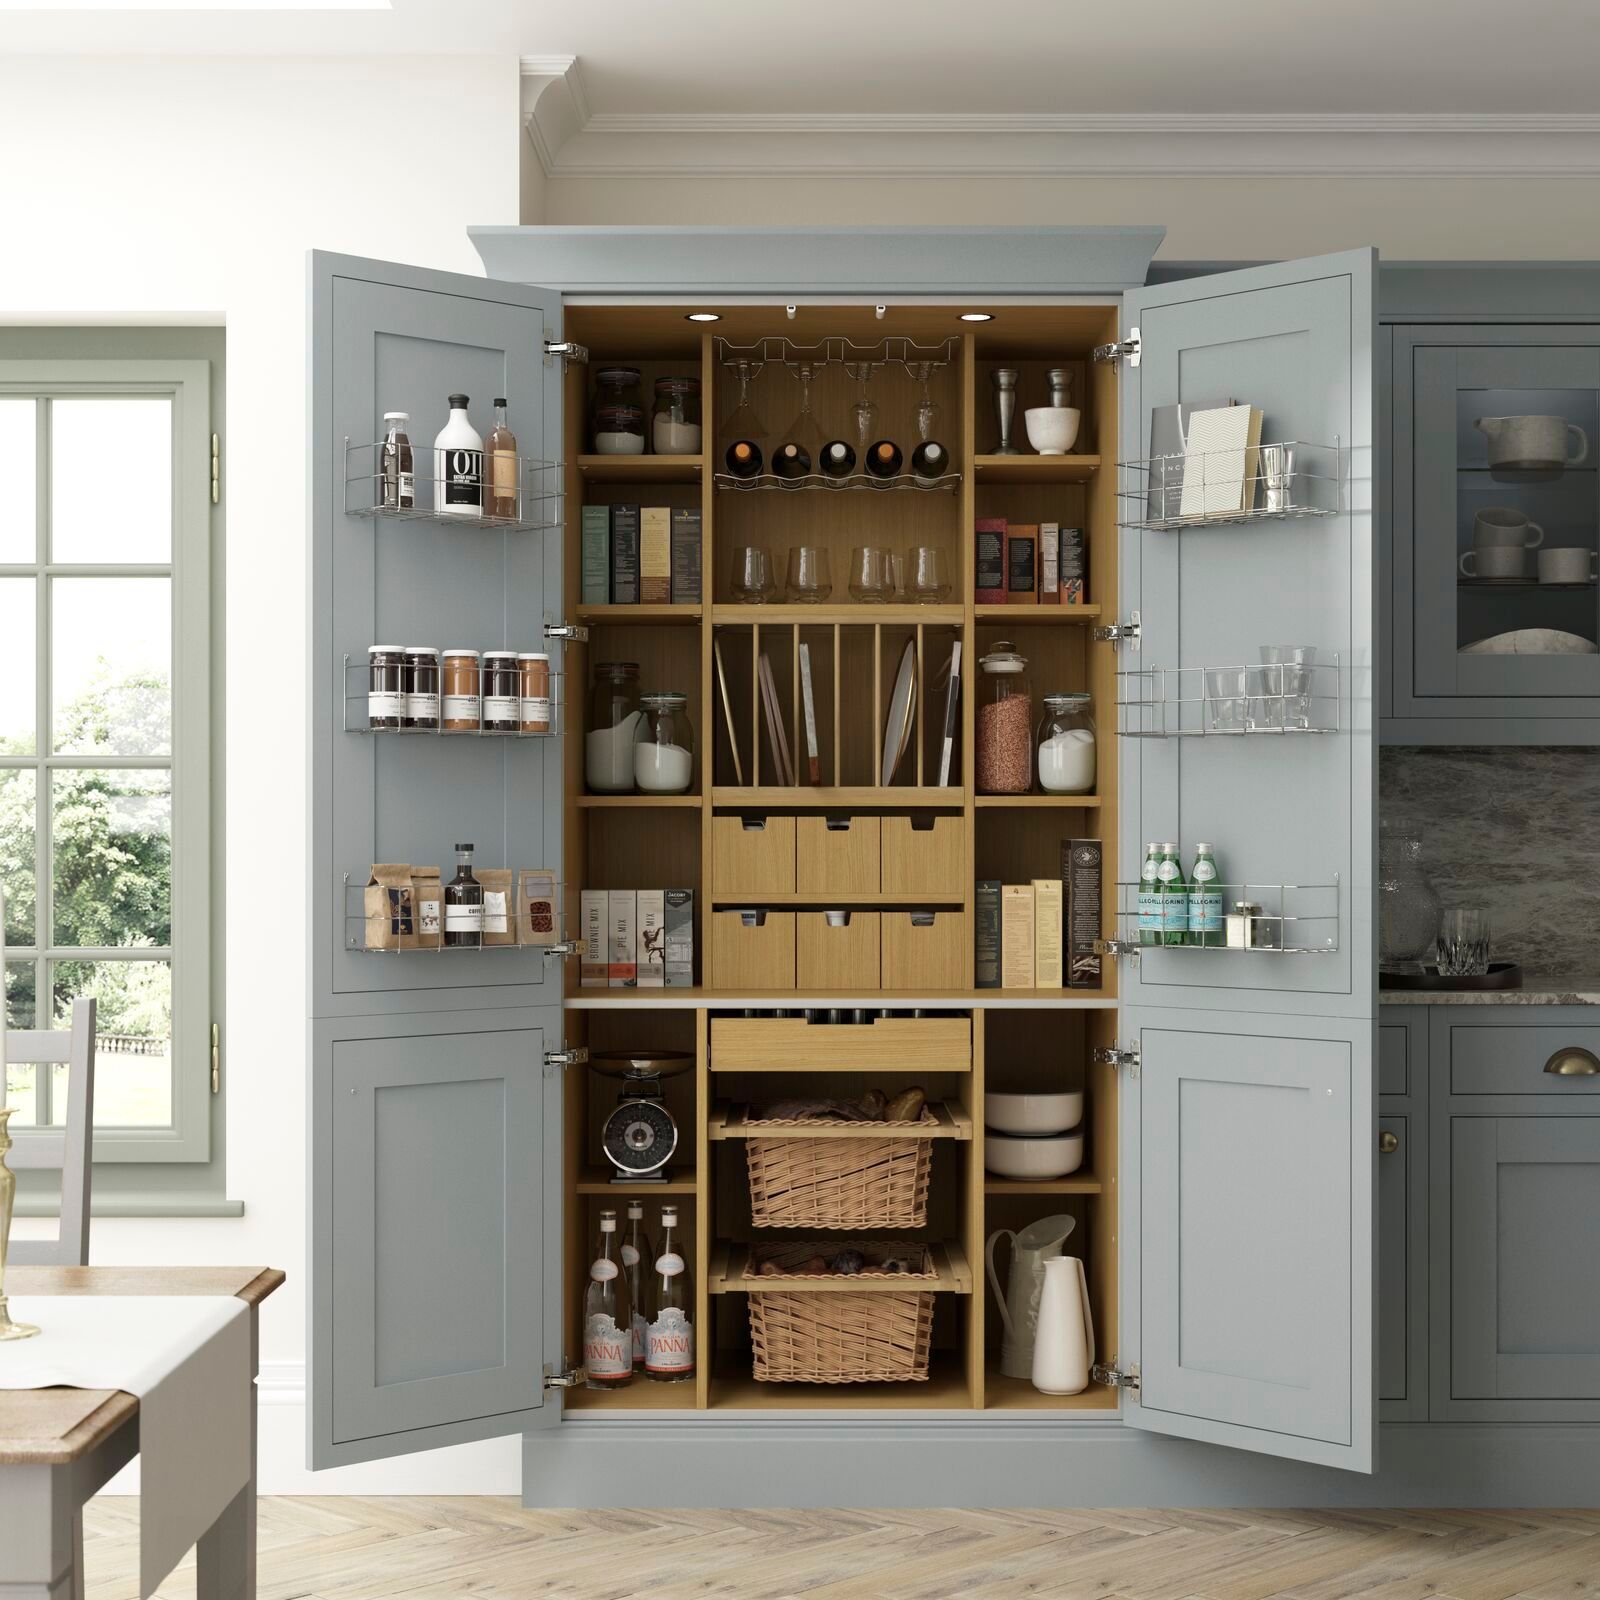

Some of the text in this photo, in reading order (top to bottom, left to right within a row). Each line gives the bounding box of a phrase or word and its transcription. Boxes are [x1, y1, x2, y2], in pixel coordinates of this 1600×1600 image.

[590, 908, 599, 922] MIX
[645, 913, 655, 927] MIX
[590, 925, 599, 959] BROWNIE
[617, 919, 627, 948] PIE MIX
[650, 1336, 690, 1354] PANNA
